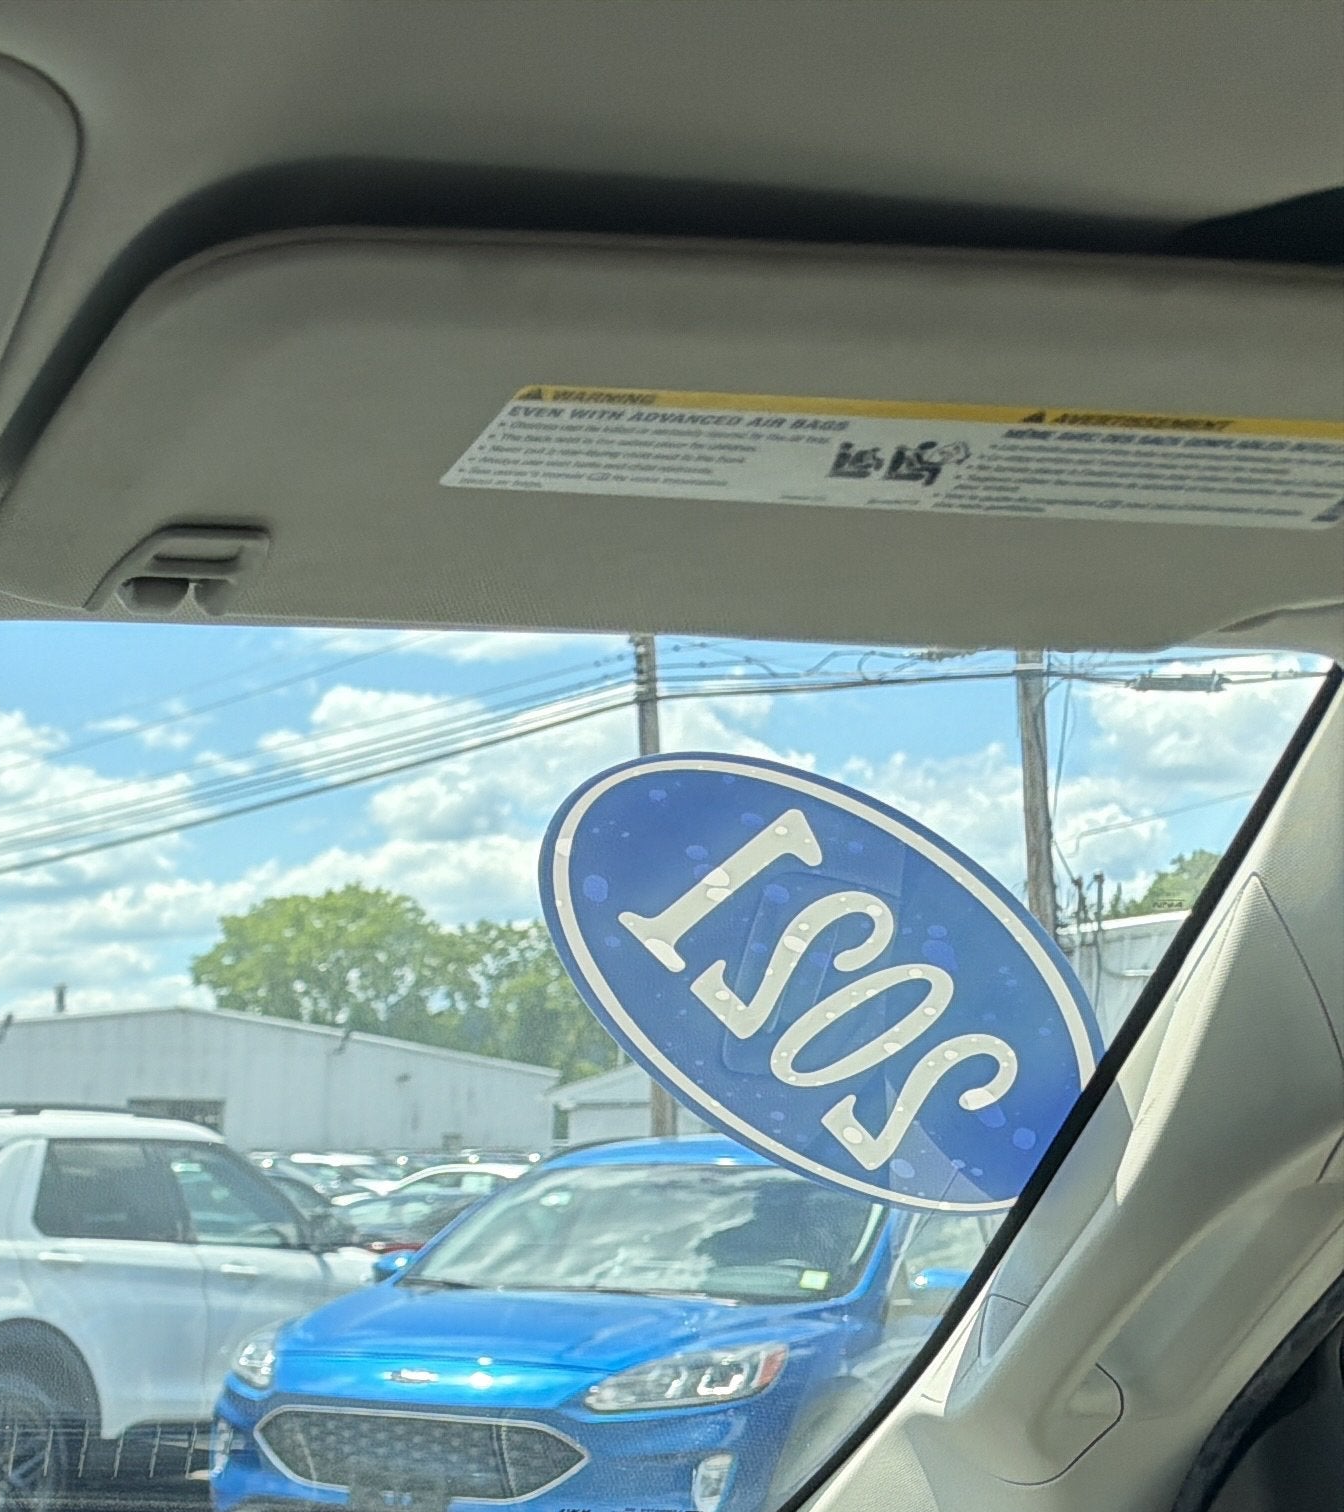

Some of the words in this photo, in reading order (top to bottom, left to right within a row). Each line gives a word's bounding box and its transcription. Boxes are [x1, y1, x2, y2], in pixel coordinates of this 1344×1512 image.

[551, 390, 656, 405] WARNING
[507, 406, 566, 419] EVEN
[569, 408, 626, 421] WITH
[626, 412, 743, 426] ADVANCED
[747, 416, 788, 428] AIR
[789, 419, 850, 431] BAGS
